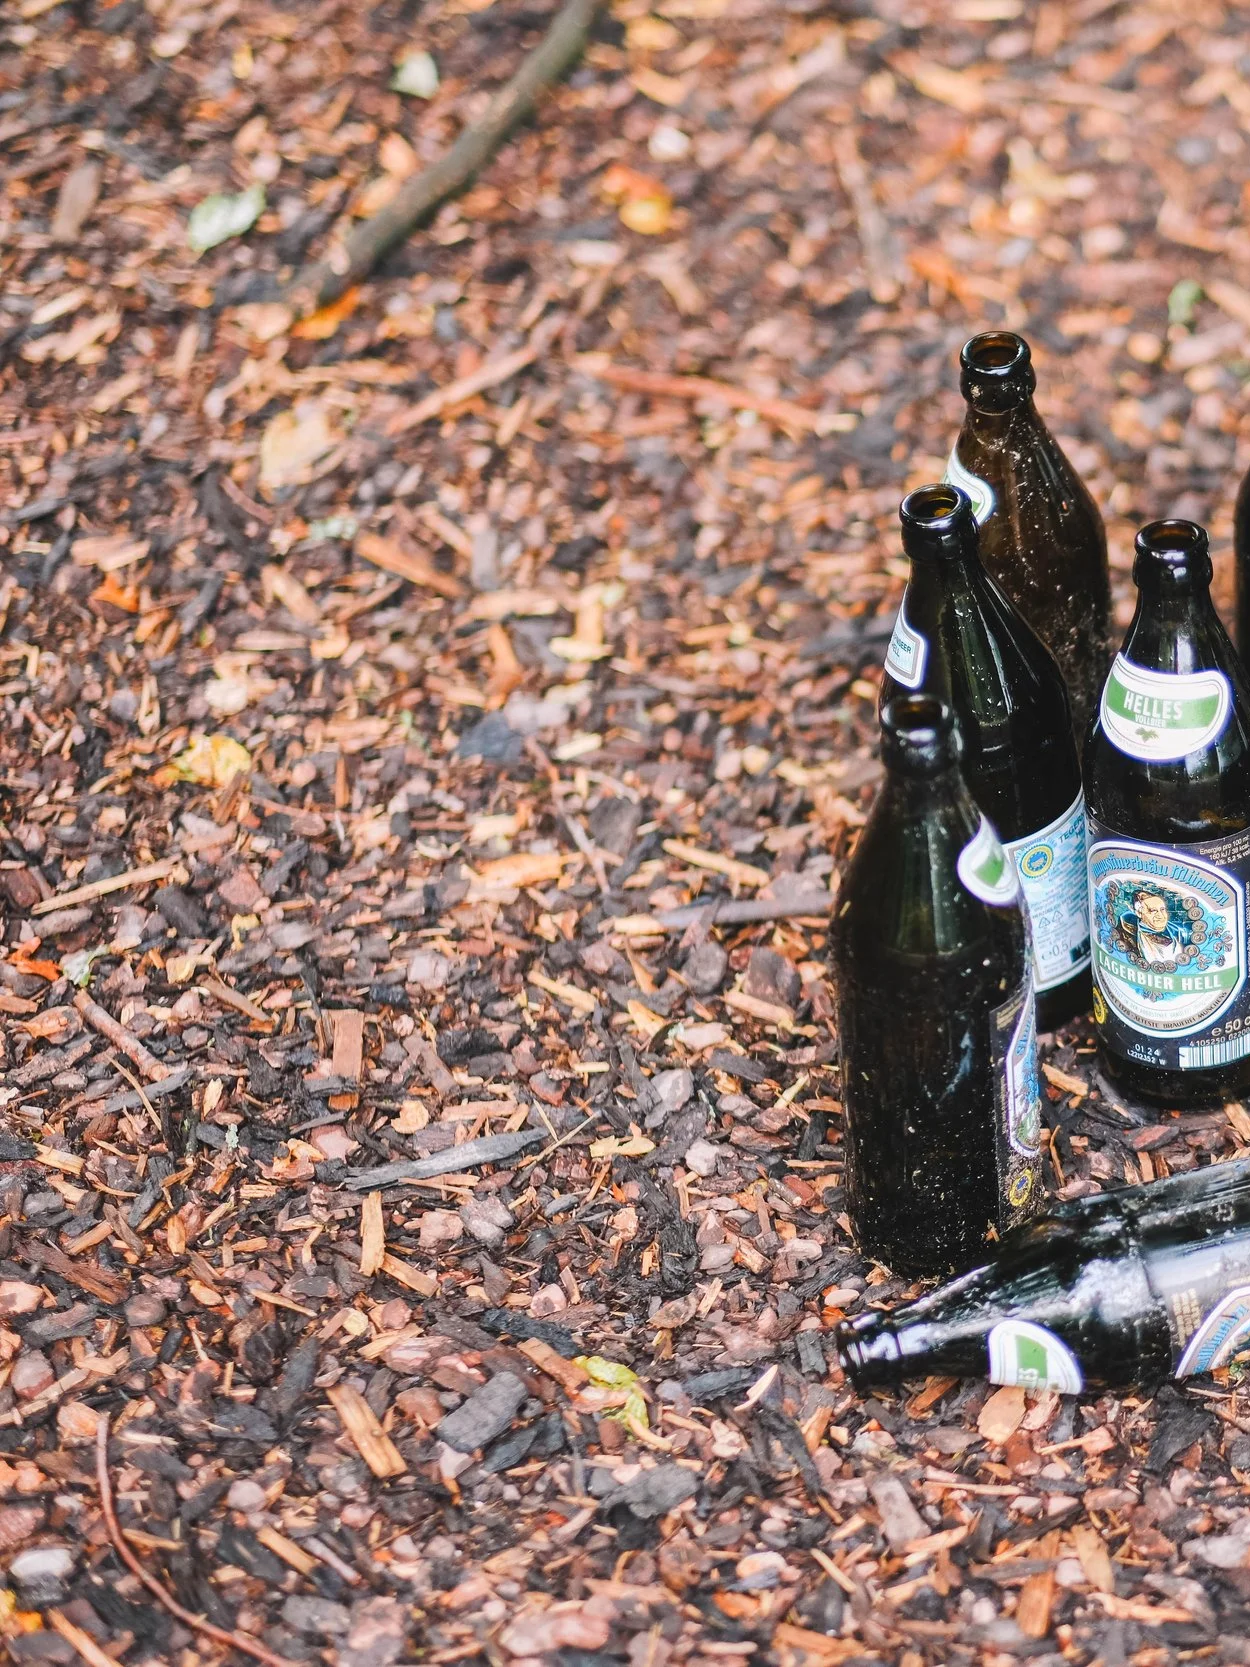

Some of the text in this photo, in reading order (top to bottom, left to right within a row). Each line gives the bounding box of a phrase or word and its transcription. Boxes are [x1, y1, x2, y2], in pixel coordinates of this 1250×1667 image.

[1124, 690, 1183, 720] HELLES
[1135, 714, 1167, 728] VOLLBIER
[1222, 843, 1232, 852] pro
[1232, 838, 1242, 847] 100
[1209, 852, 1220, 861] 160
[1170, 864, 1230, 907] München
[1099, 951, 1174, 991] LAGERBIER
[1182, 974, 1222, 991] HELL
[1224, 1017, 1242, 1034] 50
